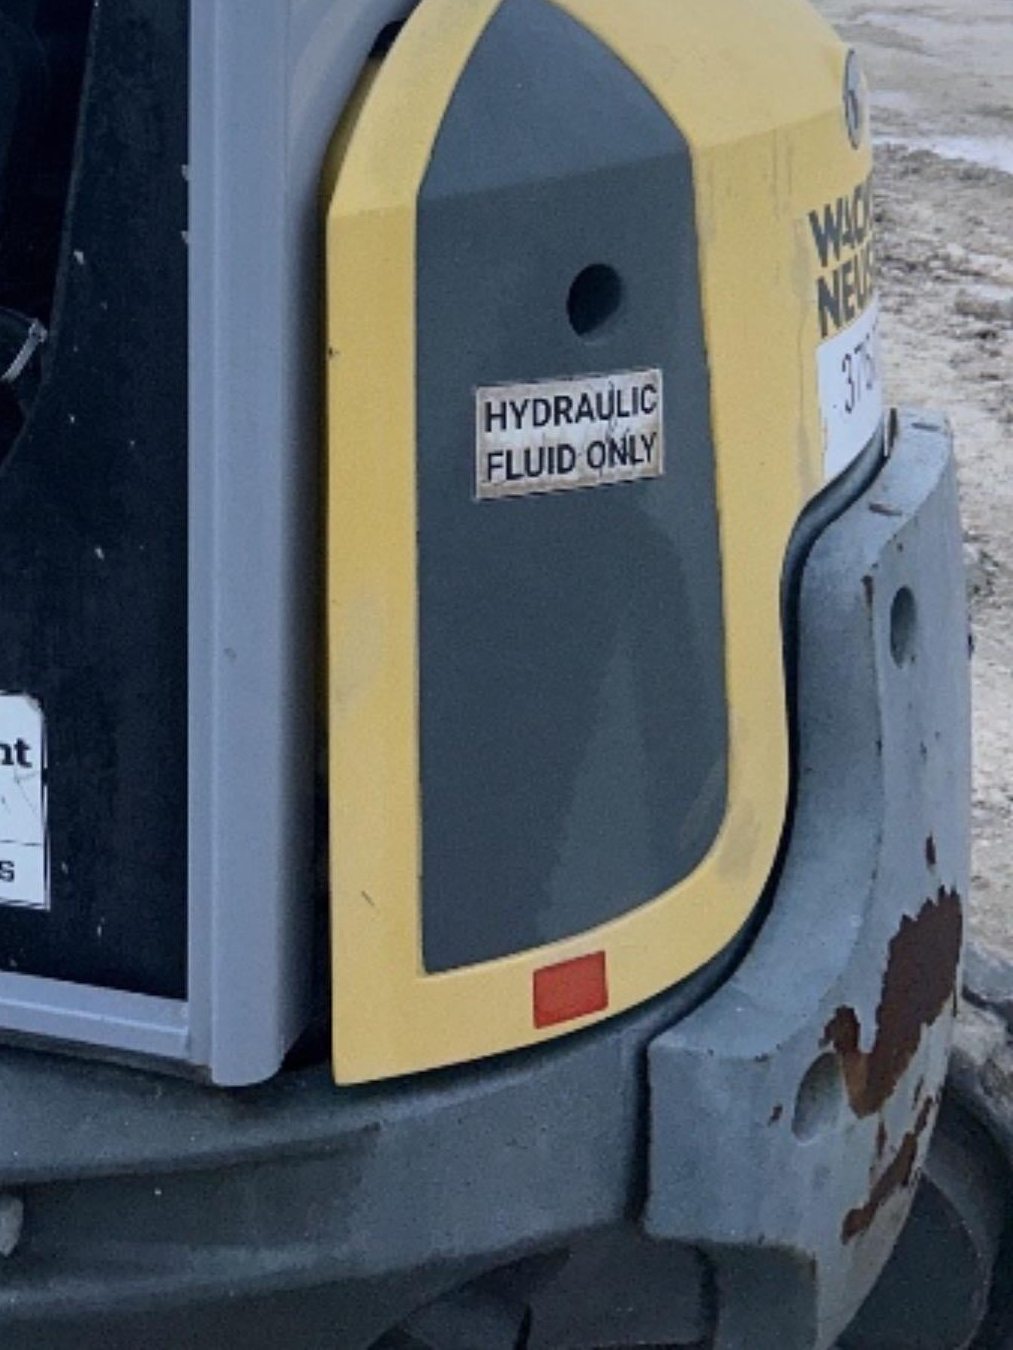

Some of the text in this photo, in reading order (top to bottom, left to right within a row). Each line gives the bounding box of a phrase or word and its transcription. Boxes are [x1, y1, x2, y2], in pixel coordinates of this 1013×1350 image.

[485, 383, 657, 433] HYDRAULIC
[487, 431, 657, 481] FLUID ONLY
